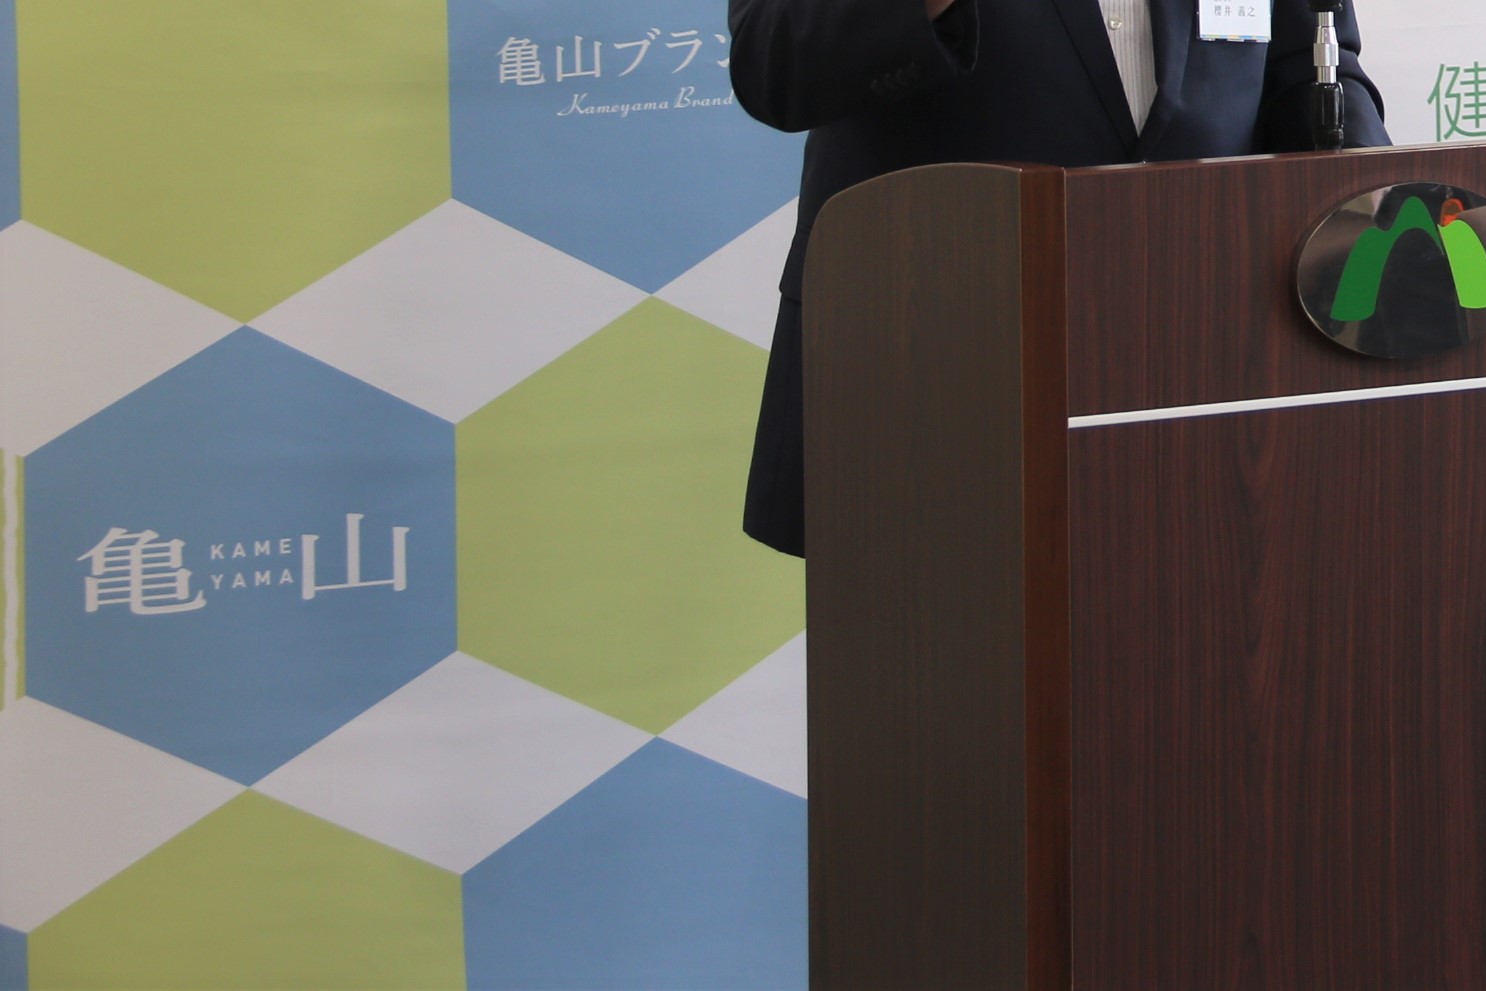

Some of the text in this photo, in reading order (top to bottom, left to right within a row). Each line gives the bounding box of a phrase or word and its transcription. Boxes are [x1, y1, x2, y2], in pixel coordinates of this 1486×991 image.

[556, 86, 735, 118] Kameyama Brand
[211, 538, 293, 560] KAME
[211, 568, 294, 590] YAMA
